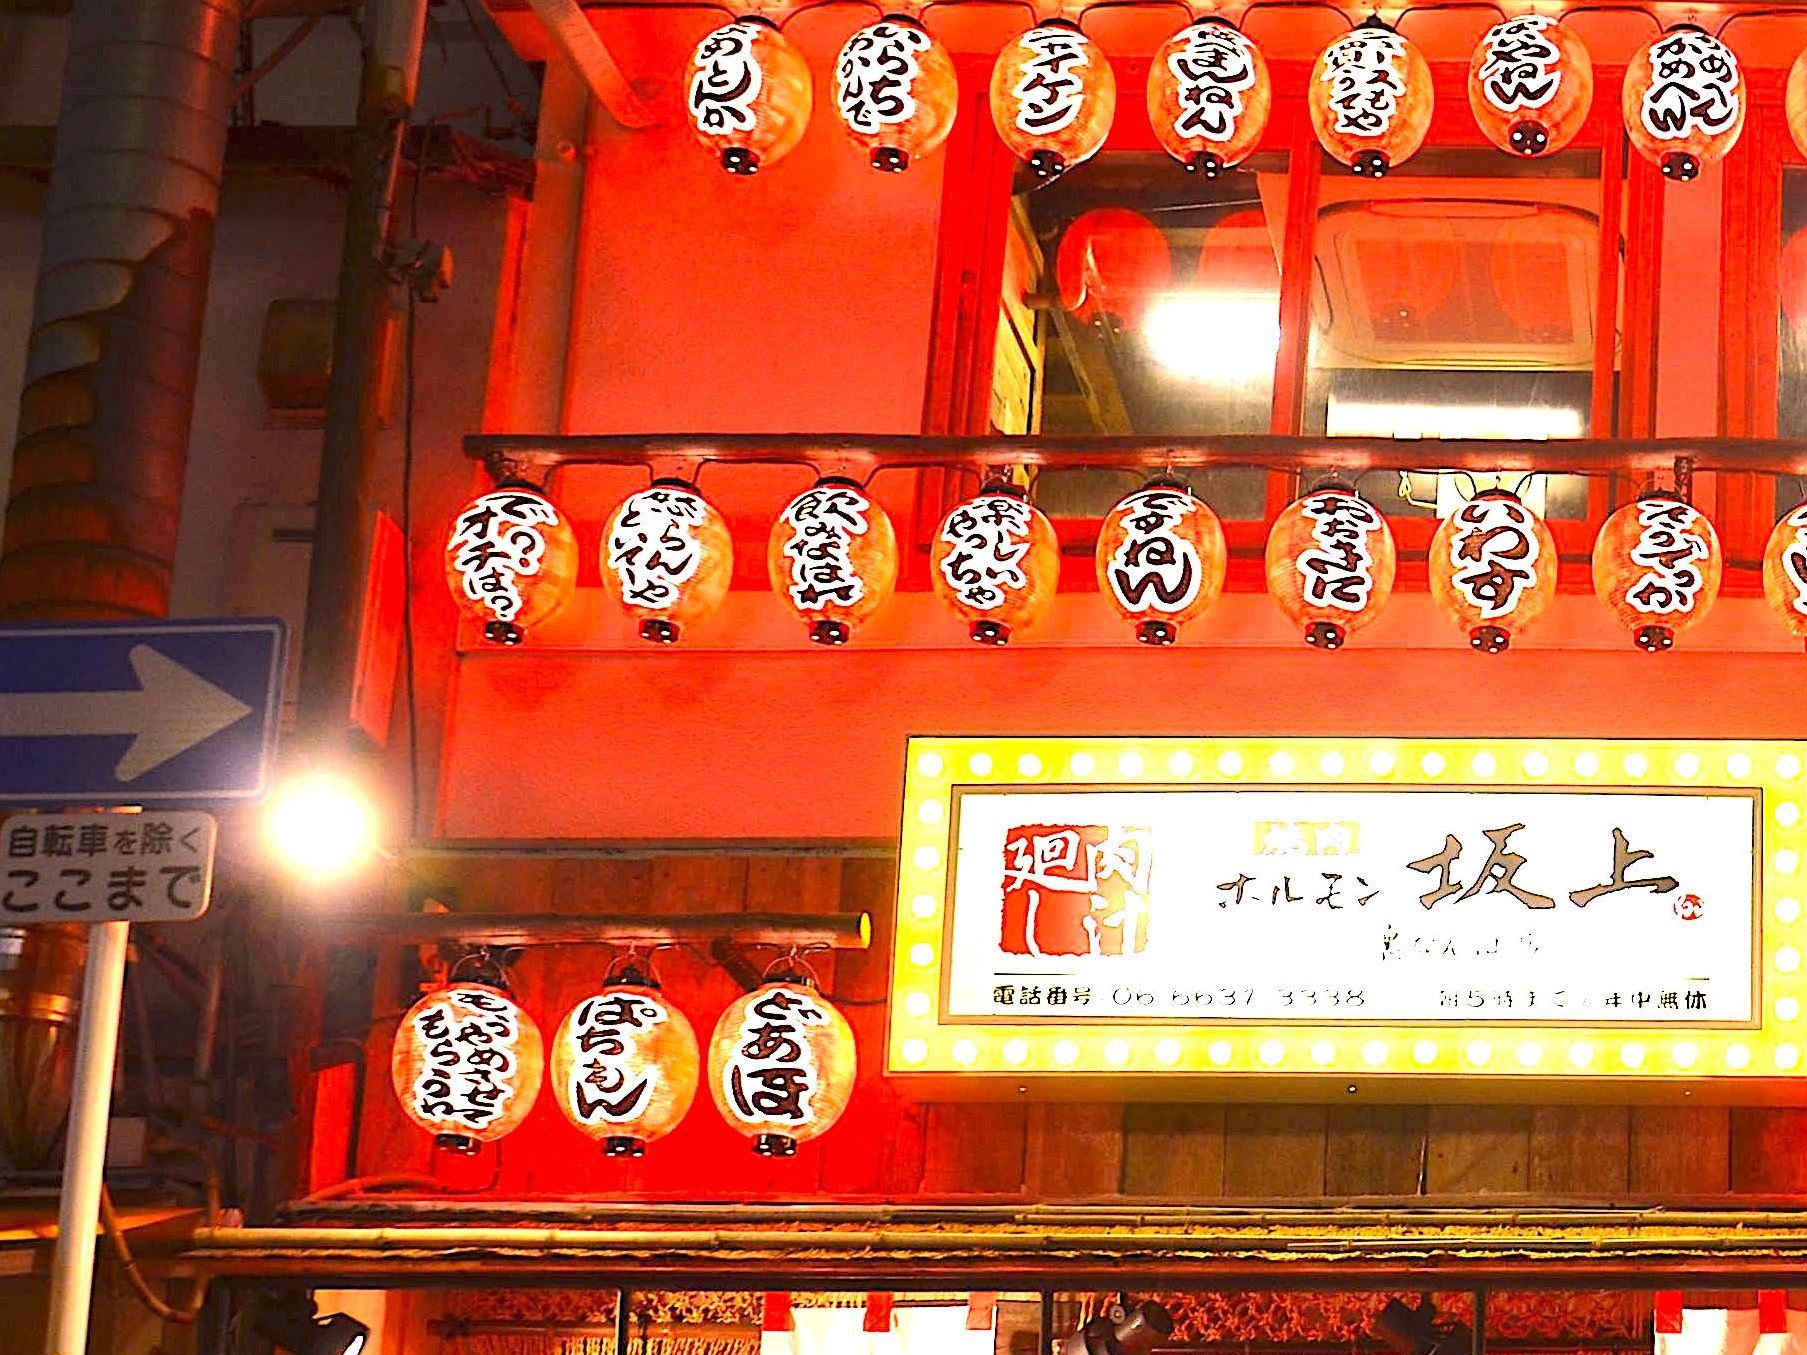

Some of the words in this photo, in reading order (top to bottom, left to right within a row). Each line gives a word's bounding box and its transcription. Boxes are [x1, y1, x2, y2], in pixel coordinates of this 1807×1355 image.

[1306, 497, 1373, 603] おおきに
[8, 821, 200, 858] 自転車を除く
[1216, 872, 1381, 910] ホルモン
[1406, 821, 1681, 911] 坂上
[3, 864, 201, 913] ここまで
[993, 985, 1092, 1006] 電話番号
[1113, 987, 1155, 1006] 06
[731, 992, 822, 1119] どあほ
